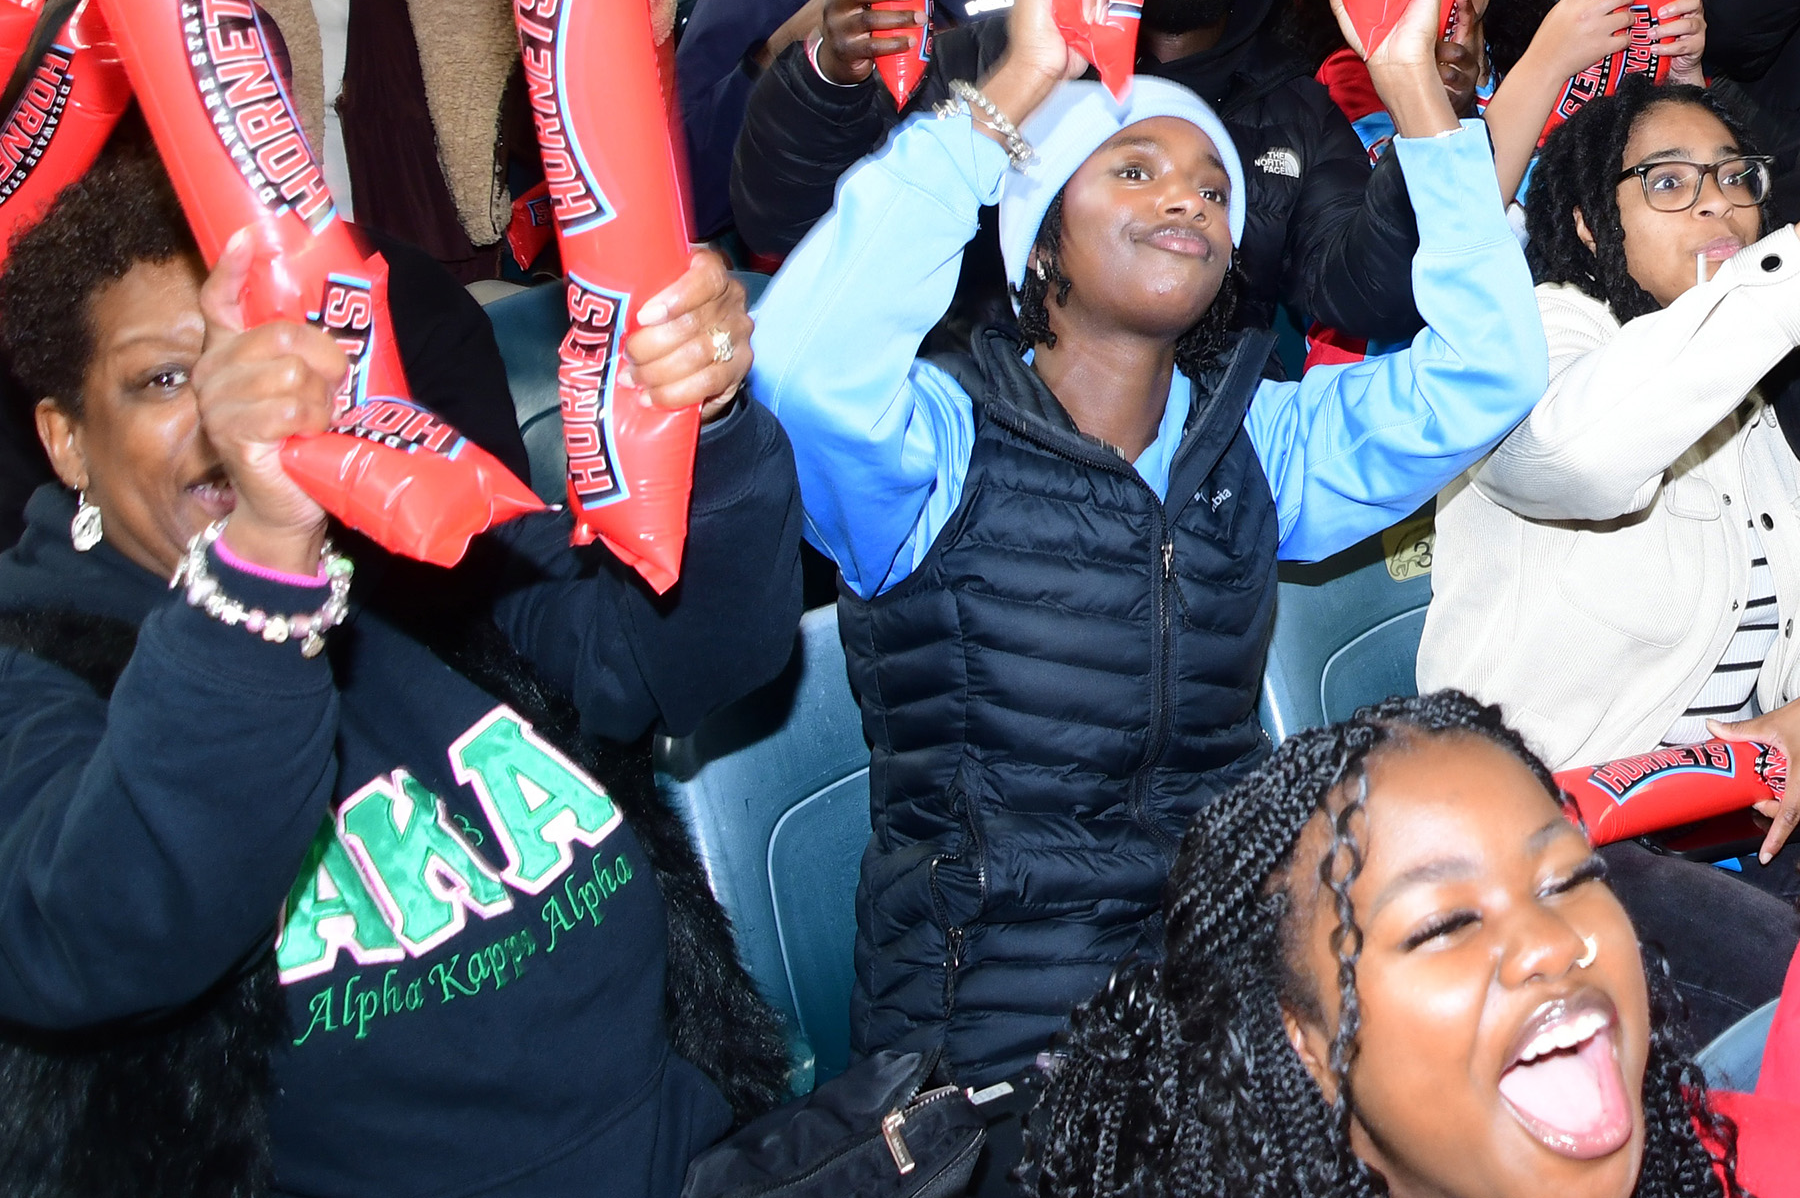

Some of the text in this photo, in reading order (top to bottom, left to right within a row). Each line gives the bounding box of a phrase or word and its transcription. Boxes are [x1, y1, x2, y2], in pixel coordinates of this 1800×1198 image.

[25, 84, 71, 167] DELAWARE
[200, 77, 278, 208] DELAWARE
[1255, 158, 1287, 168] NORTH
[1266, 151, 1286, 160] THE
[1263, 165, 1286, 176] FACE
[557, 286, 617, 497] HORNETS
[1594, 744, 1730, 793] HORNETS
[275, 704, 624, 985] AKA
[293, 853, 633, 1046] Alpha Kappa Alpha
